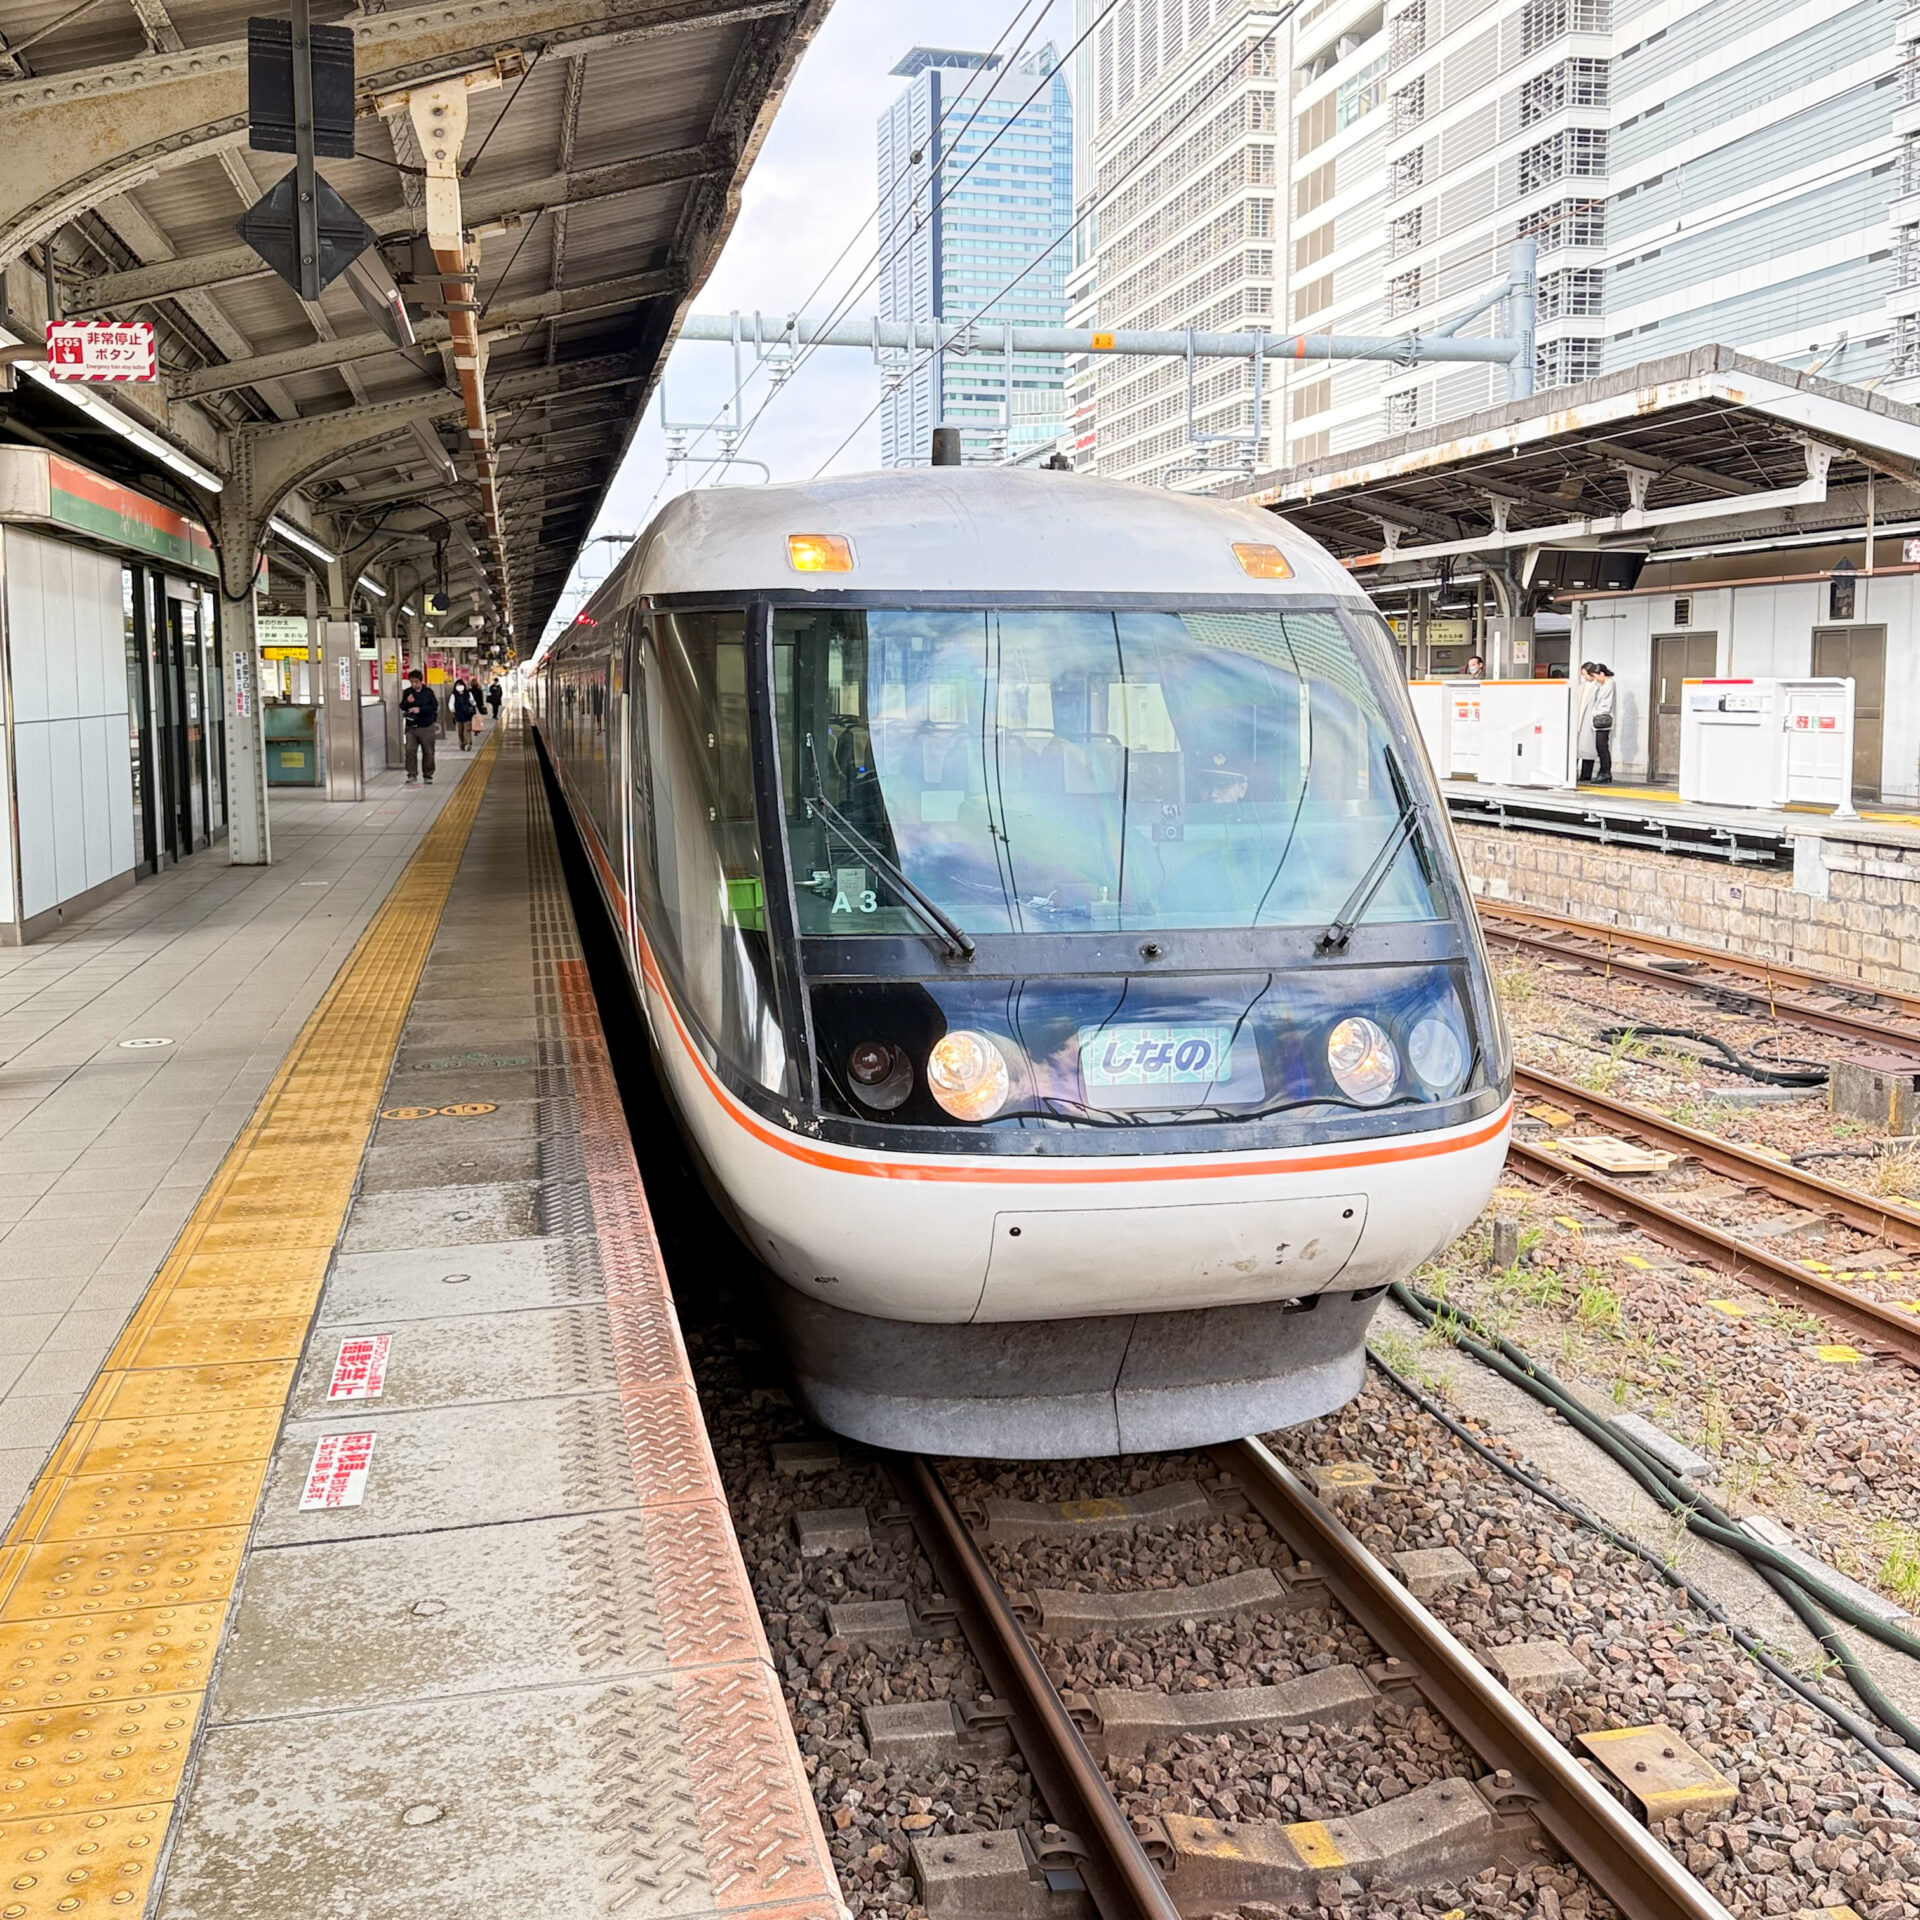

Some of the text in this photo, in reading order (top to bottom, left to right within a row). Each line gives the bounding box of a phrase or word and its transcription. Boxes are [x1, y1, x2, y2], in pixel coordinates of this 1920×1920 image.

[57, 339, 80, 347] SOS
[87, 332, 142, 345] 非常停止
[95, 348, 136, 361] ボタン
[431, 659, 438, 668] 3
[1101, 1039, 1212, 1074] しなの
[330, 1340, 374, 1397] 撮影禁止
